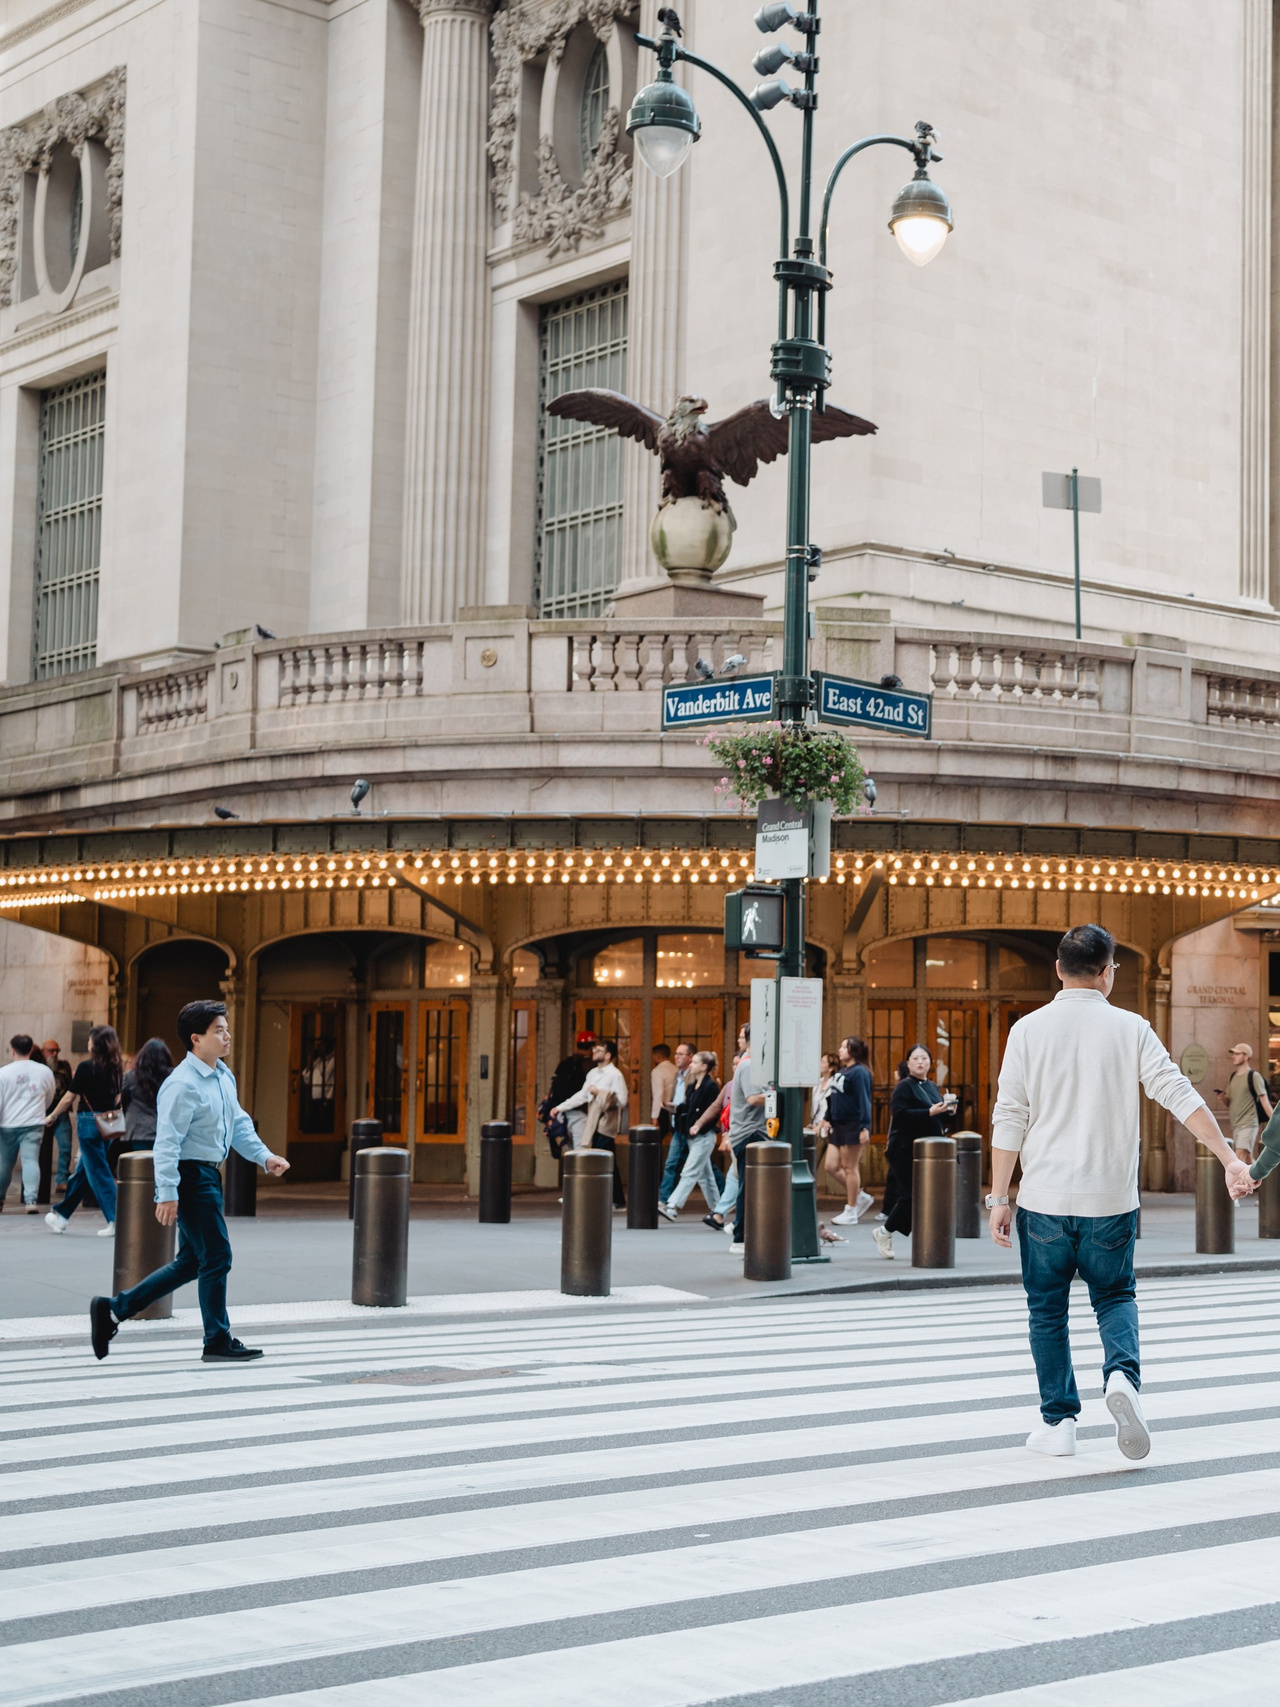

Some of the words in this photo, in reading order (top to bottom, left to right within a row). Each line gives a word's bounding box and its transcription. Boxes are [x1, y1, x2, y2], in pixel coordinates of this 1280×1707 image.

[666, 689, 740, 718] Vanderbilt
[741, 688, 771, 710] Ave
[826, 687, 863, 715] East
[865, 696, 904, 723] 42nd
[906, 704, 925, 727] St
[761, 822, 780, 832] Grand
[780, 818, 803, 830] Central
[761, 833, 790, 844] Madison
[1186, 985, 1214, 994] GRAND
[1214, 986, 1247, 995] CENTRAL
[1199, 995, 1236, 1004] TERMINAL
